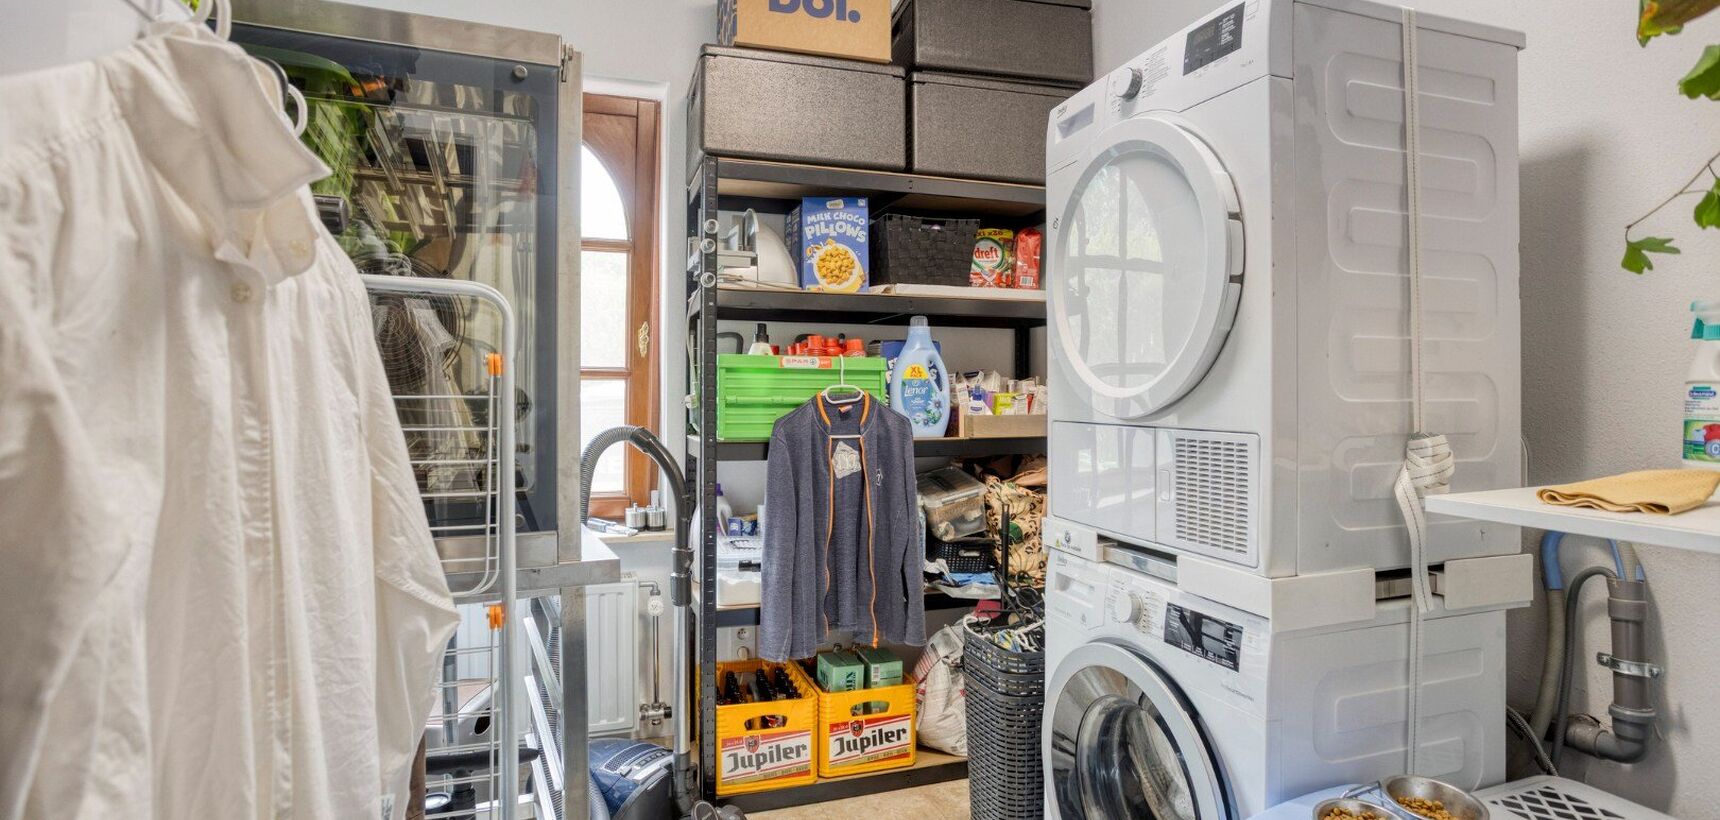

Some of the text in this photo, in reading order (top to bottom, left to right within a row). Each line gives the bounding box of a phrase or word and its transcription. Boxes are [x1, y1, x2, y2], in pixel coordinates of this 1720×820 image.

[807, 212, 865, 225] MILK CHOCO
[805, 221, 867, 242] PILLOWS
[974, 246, 999, 259] dreft
[904, 385, 929, 397] Lenor
[833, 728, 907, 757] Jupiler
[726, 743, 808, 773] Jupiler
